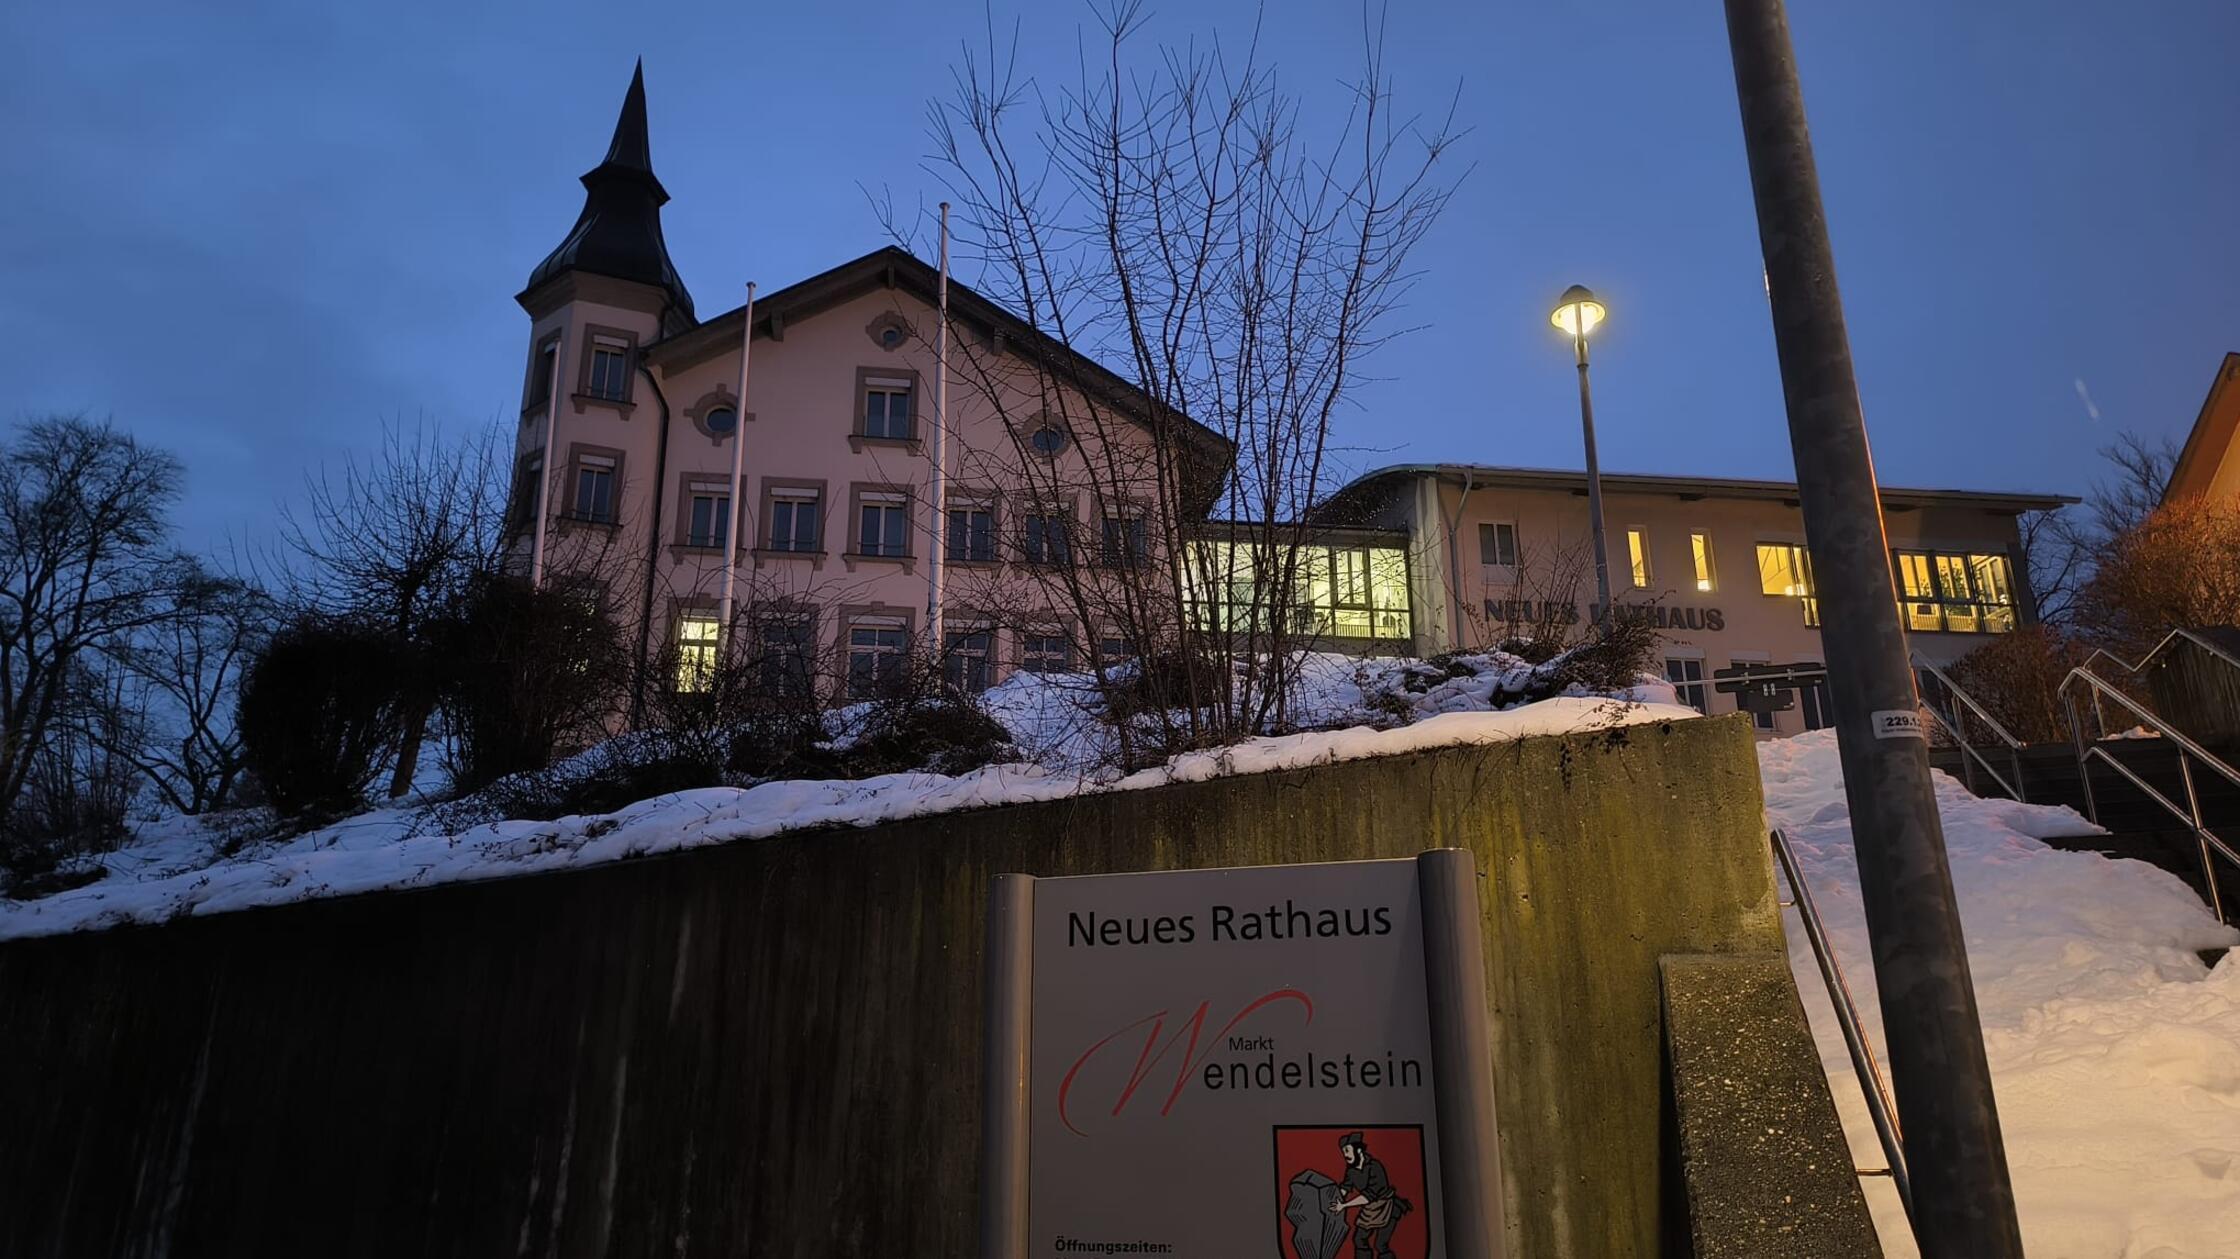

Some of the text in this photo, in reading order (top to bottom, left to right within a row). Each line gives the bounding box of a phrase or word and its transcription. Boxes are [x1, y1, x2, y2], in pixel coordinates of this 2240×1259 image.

[1068, 900, 1392, 947] Neues Rathaus
[1228, 1035, 1275, 1053] Markt
[1055, 1235, 1173, 1255] Öffnungszeiten:
